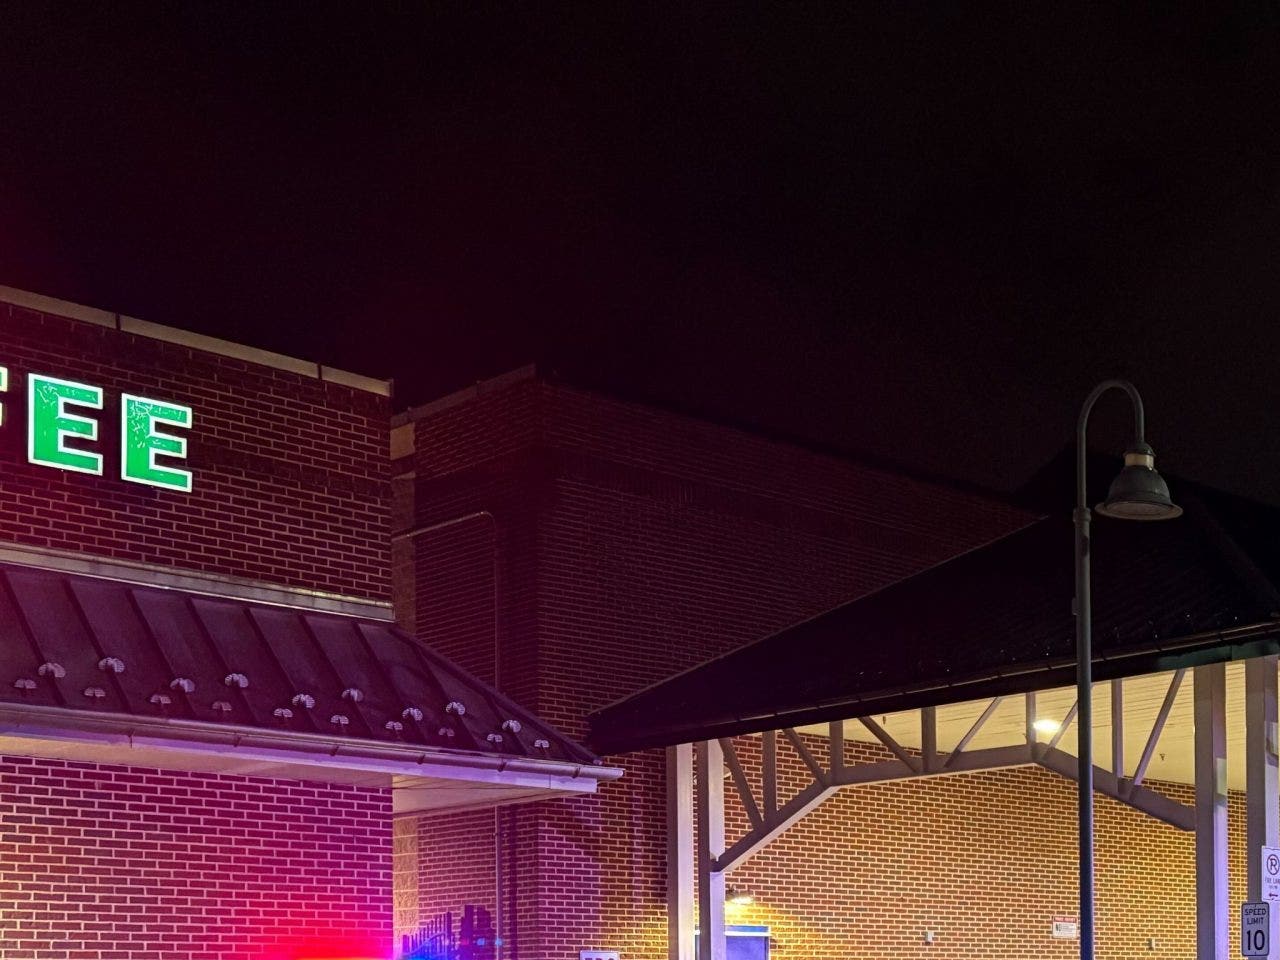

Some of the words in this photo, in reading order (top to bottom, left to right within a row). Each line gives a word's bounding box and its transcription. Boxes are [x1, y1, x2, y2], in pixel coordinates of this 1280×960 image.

[0, 366, 192, 492] EE
[1244, 908, 1266, 916] SPEED
[1246, 917, 1264, 925] LIMIT
[1246, 929, 1265, 951] 10
